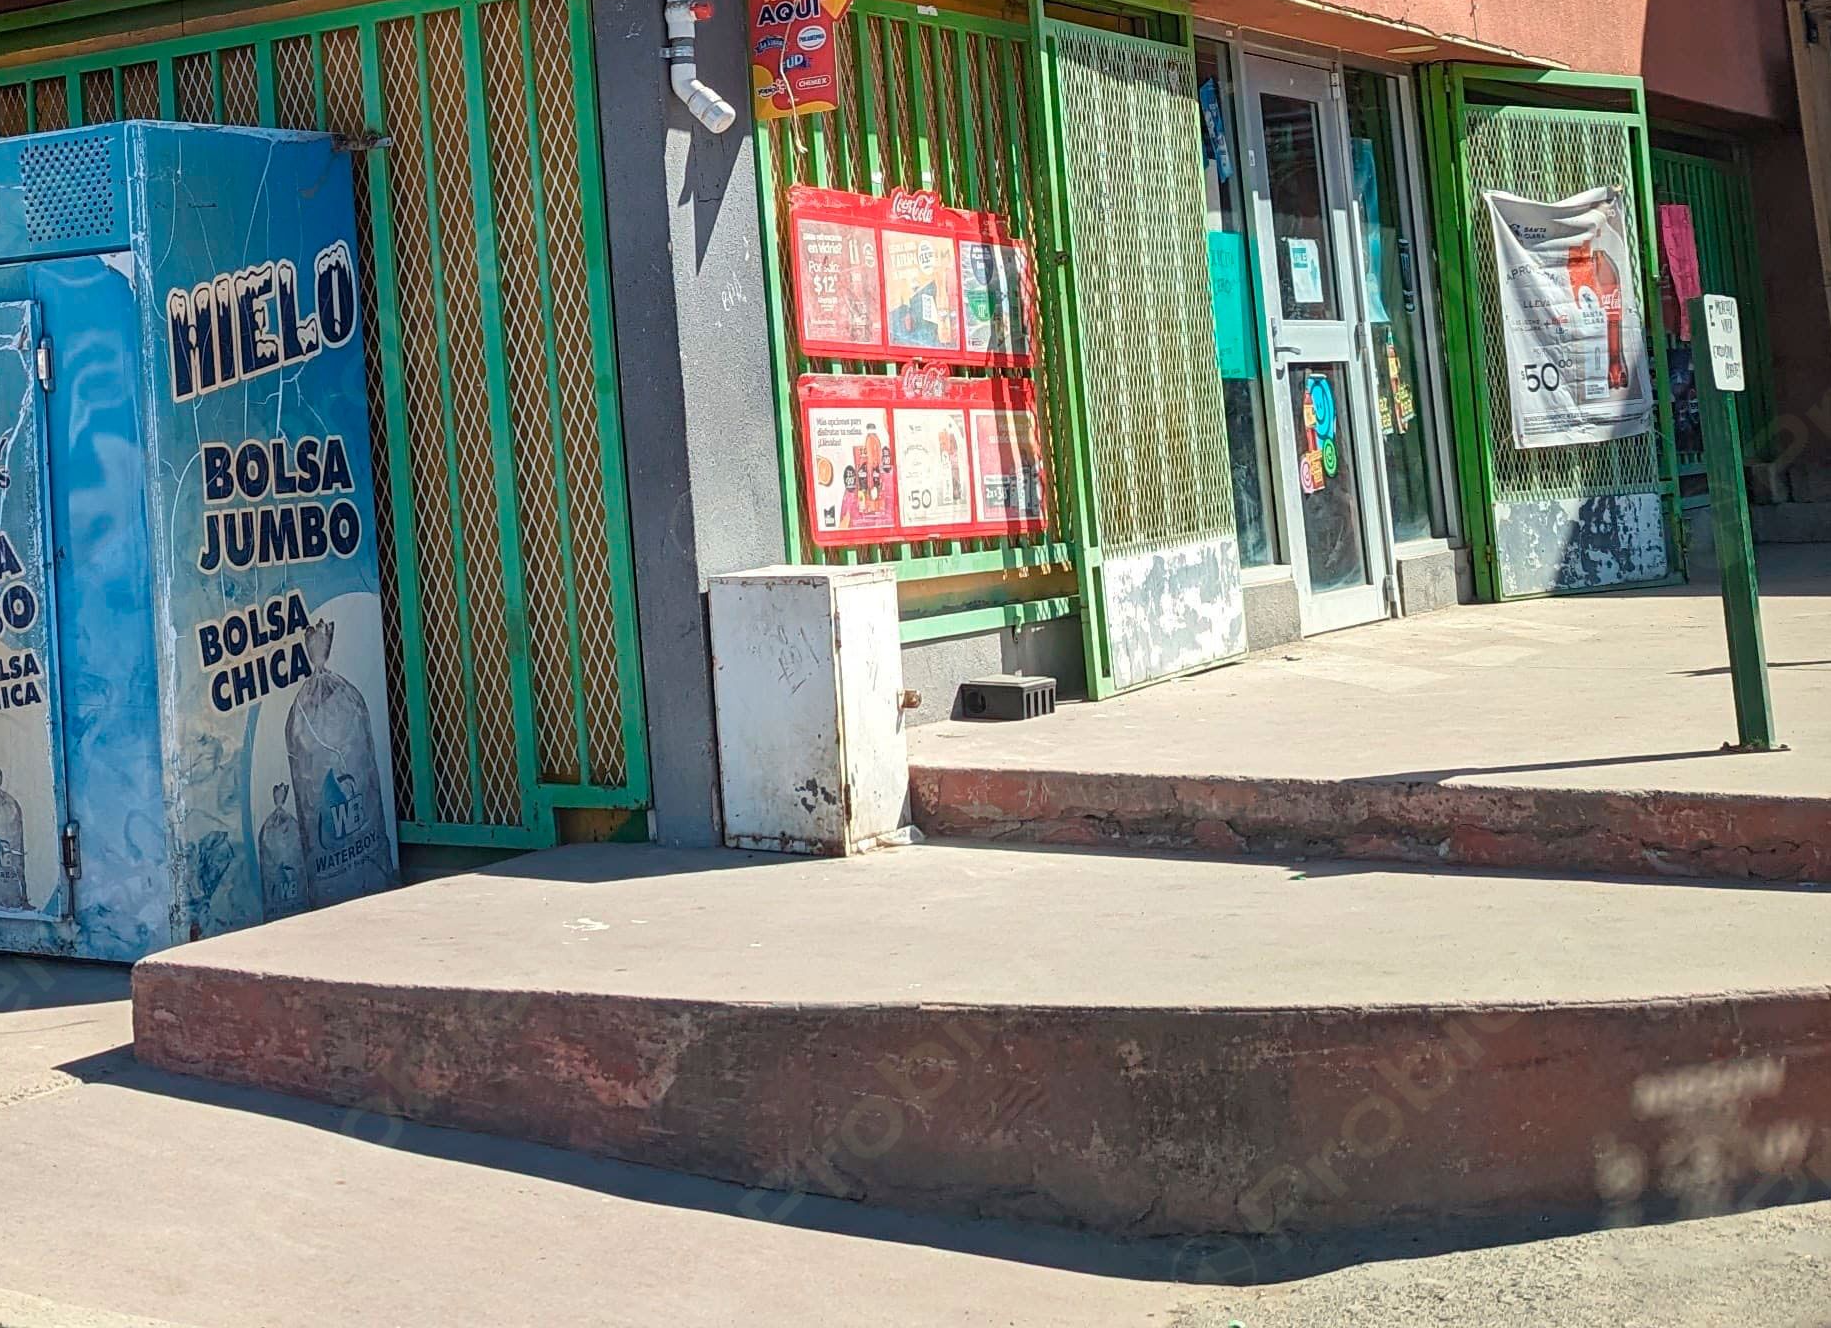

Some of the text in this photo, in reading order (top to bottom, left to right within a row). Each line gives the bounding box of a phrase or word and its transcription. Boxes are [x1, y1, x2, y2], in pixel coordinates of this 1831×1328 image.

[169, 242, 357, 402] HIELO
[203, 437, 353, 502] BOLSA
[200, 502, 361, 574] JUMBO
[200, 591, 310, 668] BOLSA
[211, 642, 314, 715] CHICA
